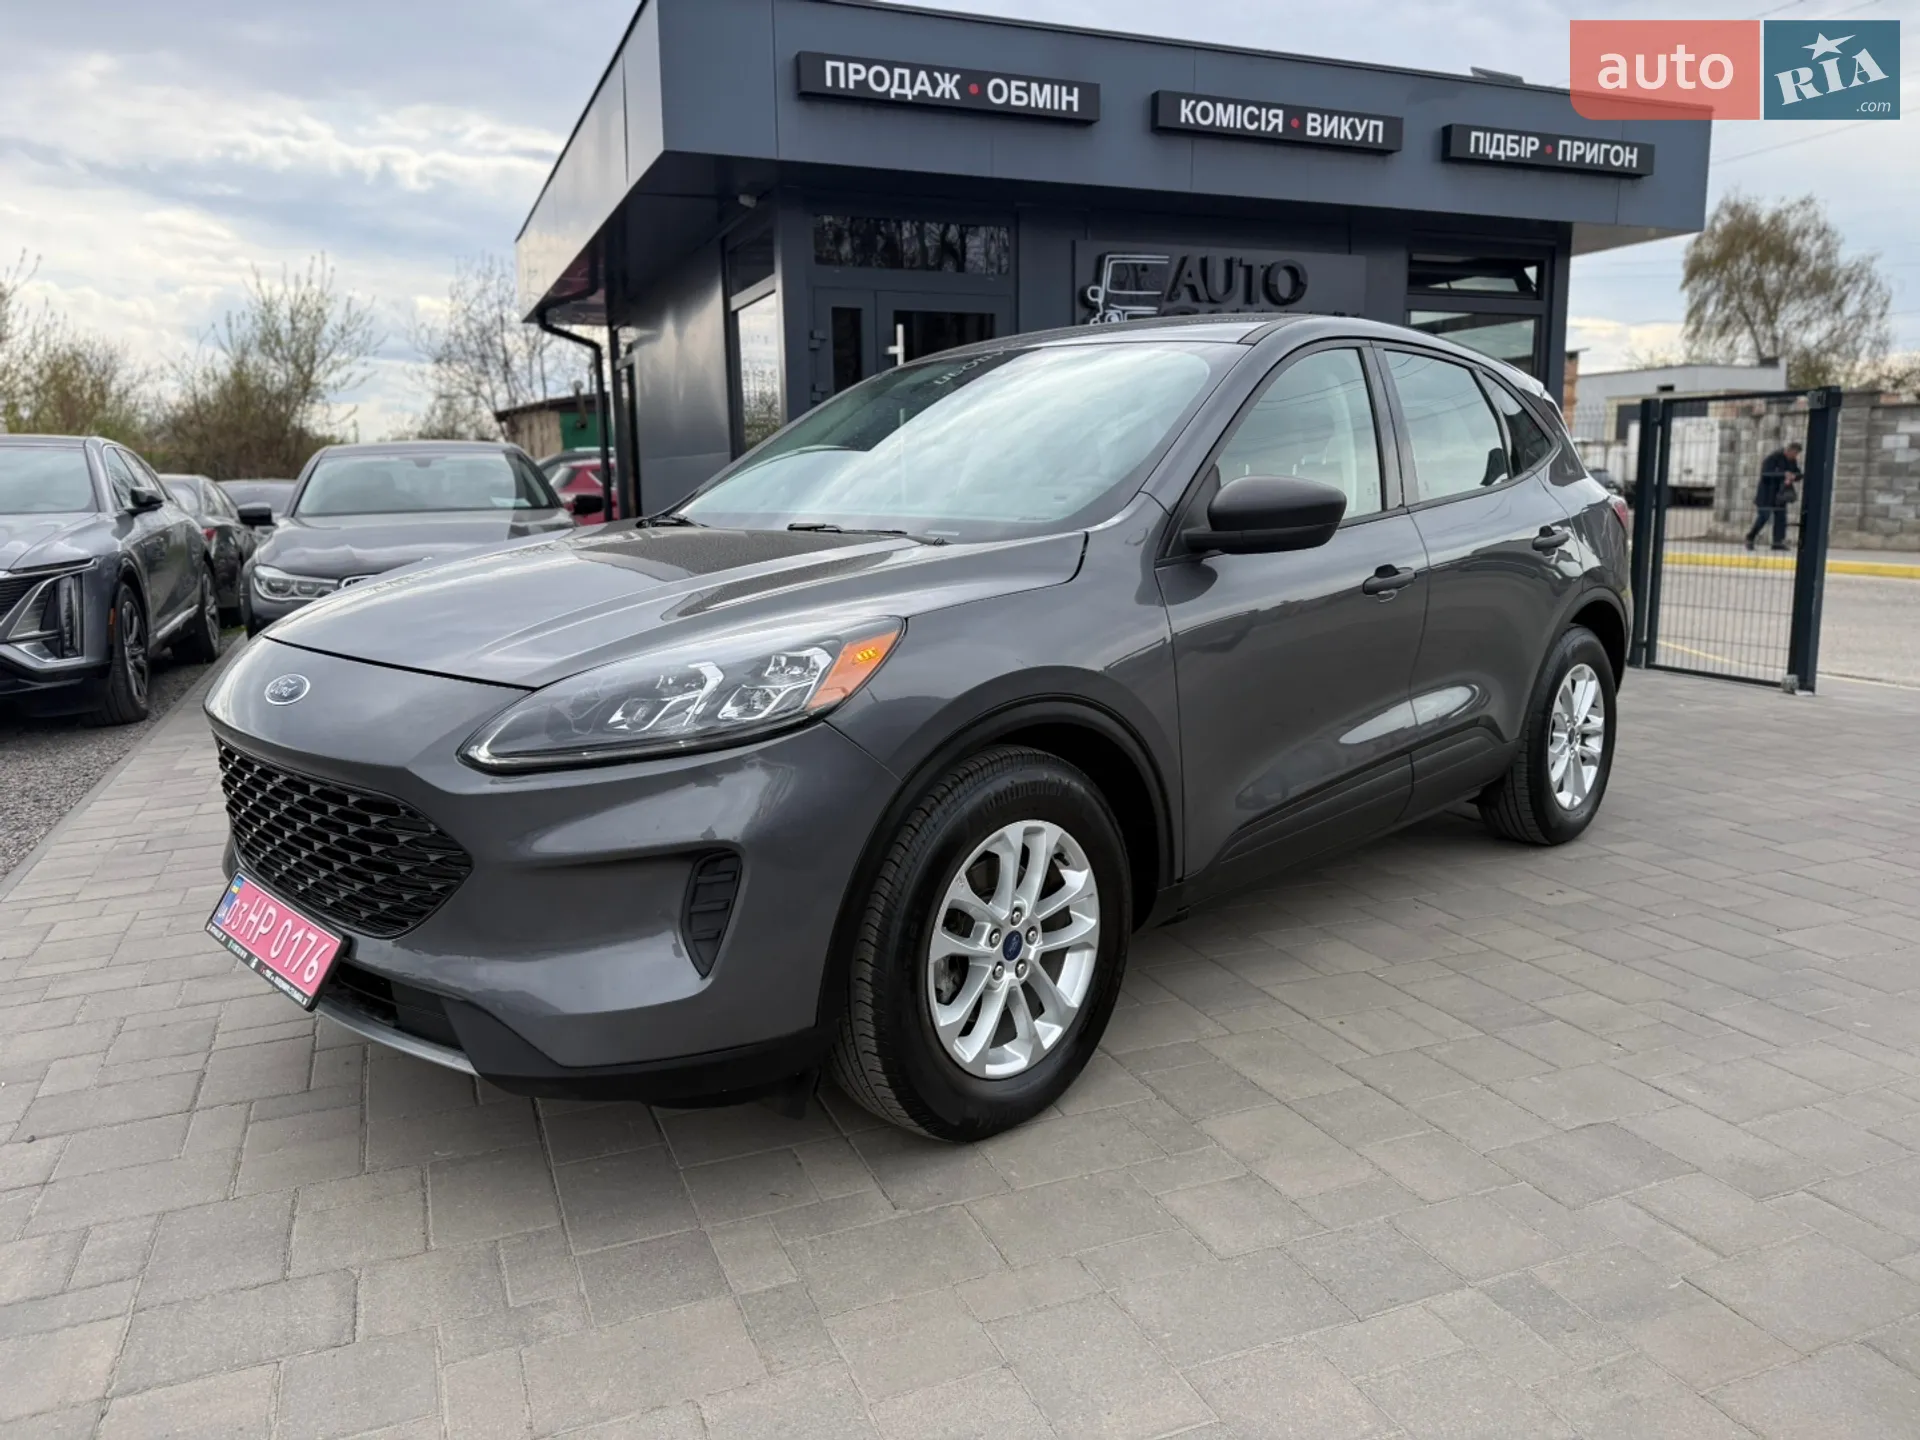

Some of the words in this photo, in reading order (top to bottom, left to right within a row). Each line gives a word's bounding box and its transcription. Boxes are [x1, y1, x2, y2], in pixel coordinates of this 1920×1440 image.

[825, 60, 961, 100] ПРОДАЖ
[987, 78, 1079, 112] ОБМІН
[1180, 99, 1284, 133] КОМІСІЯ
[1306, 112, 1384, 144] ВИКУП
[1469, 131, 1540, 161] ПІДБІР
[1557, 139, 1638, 168] ПРИГОН
[1165, 254, 1309, 307] AUTO
[269, 918, 331, 984] 0176
